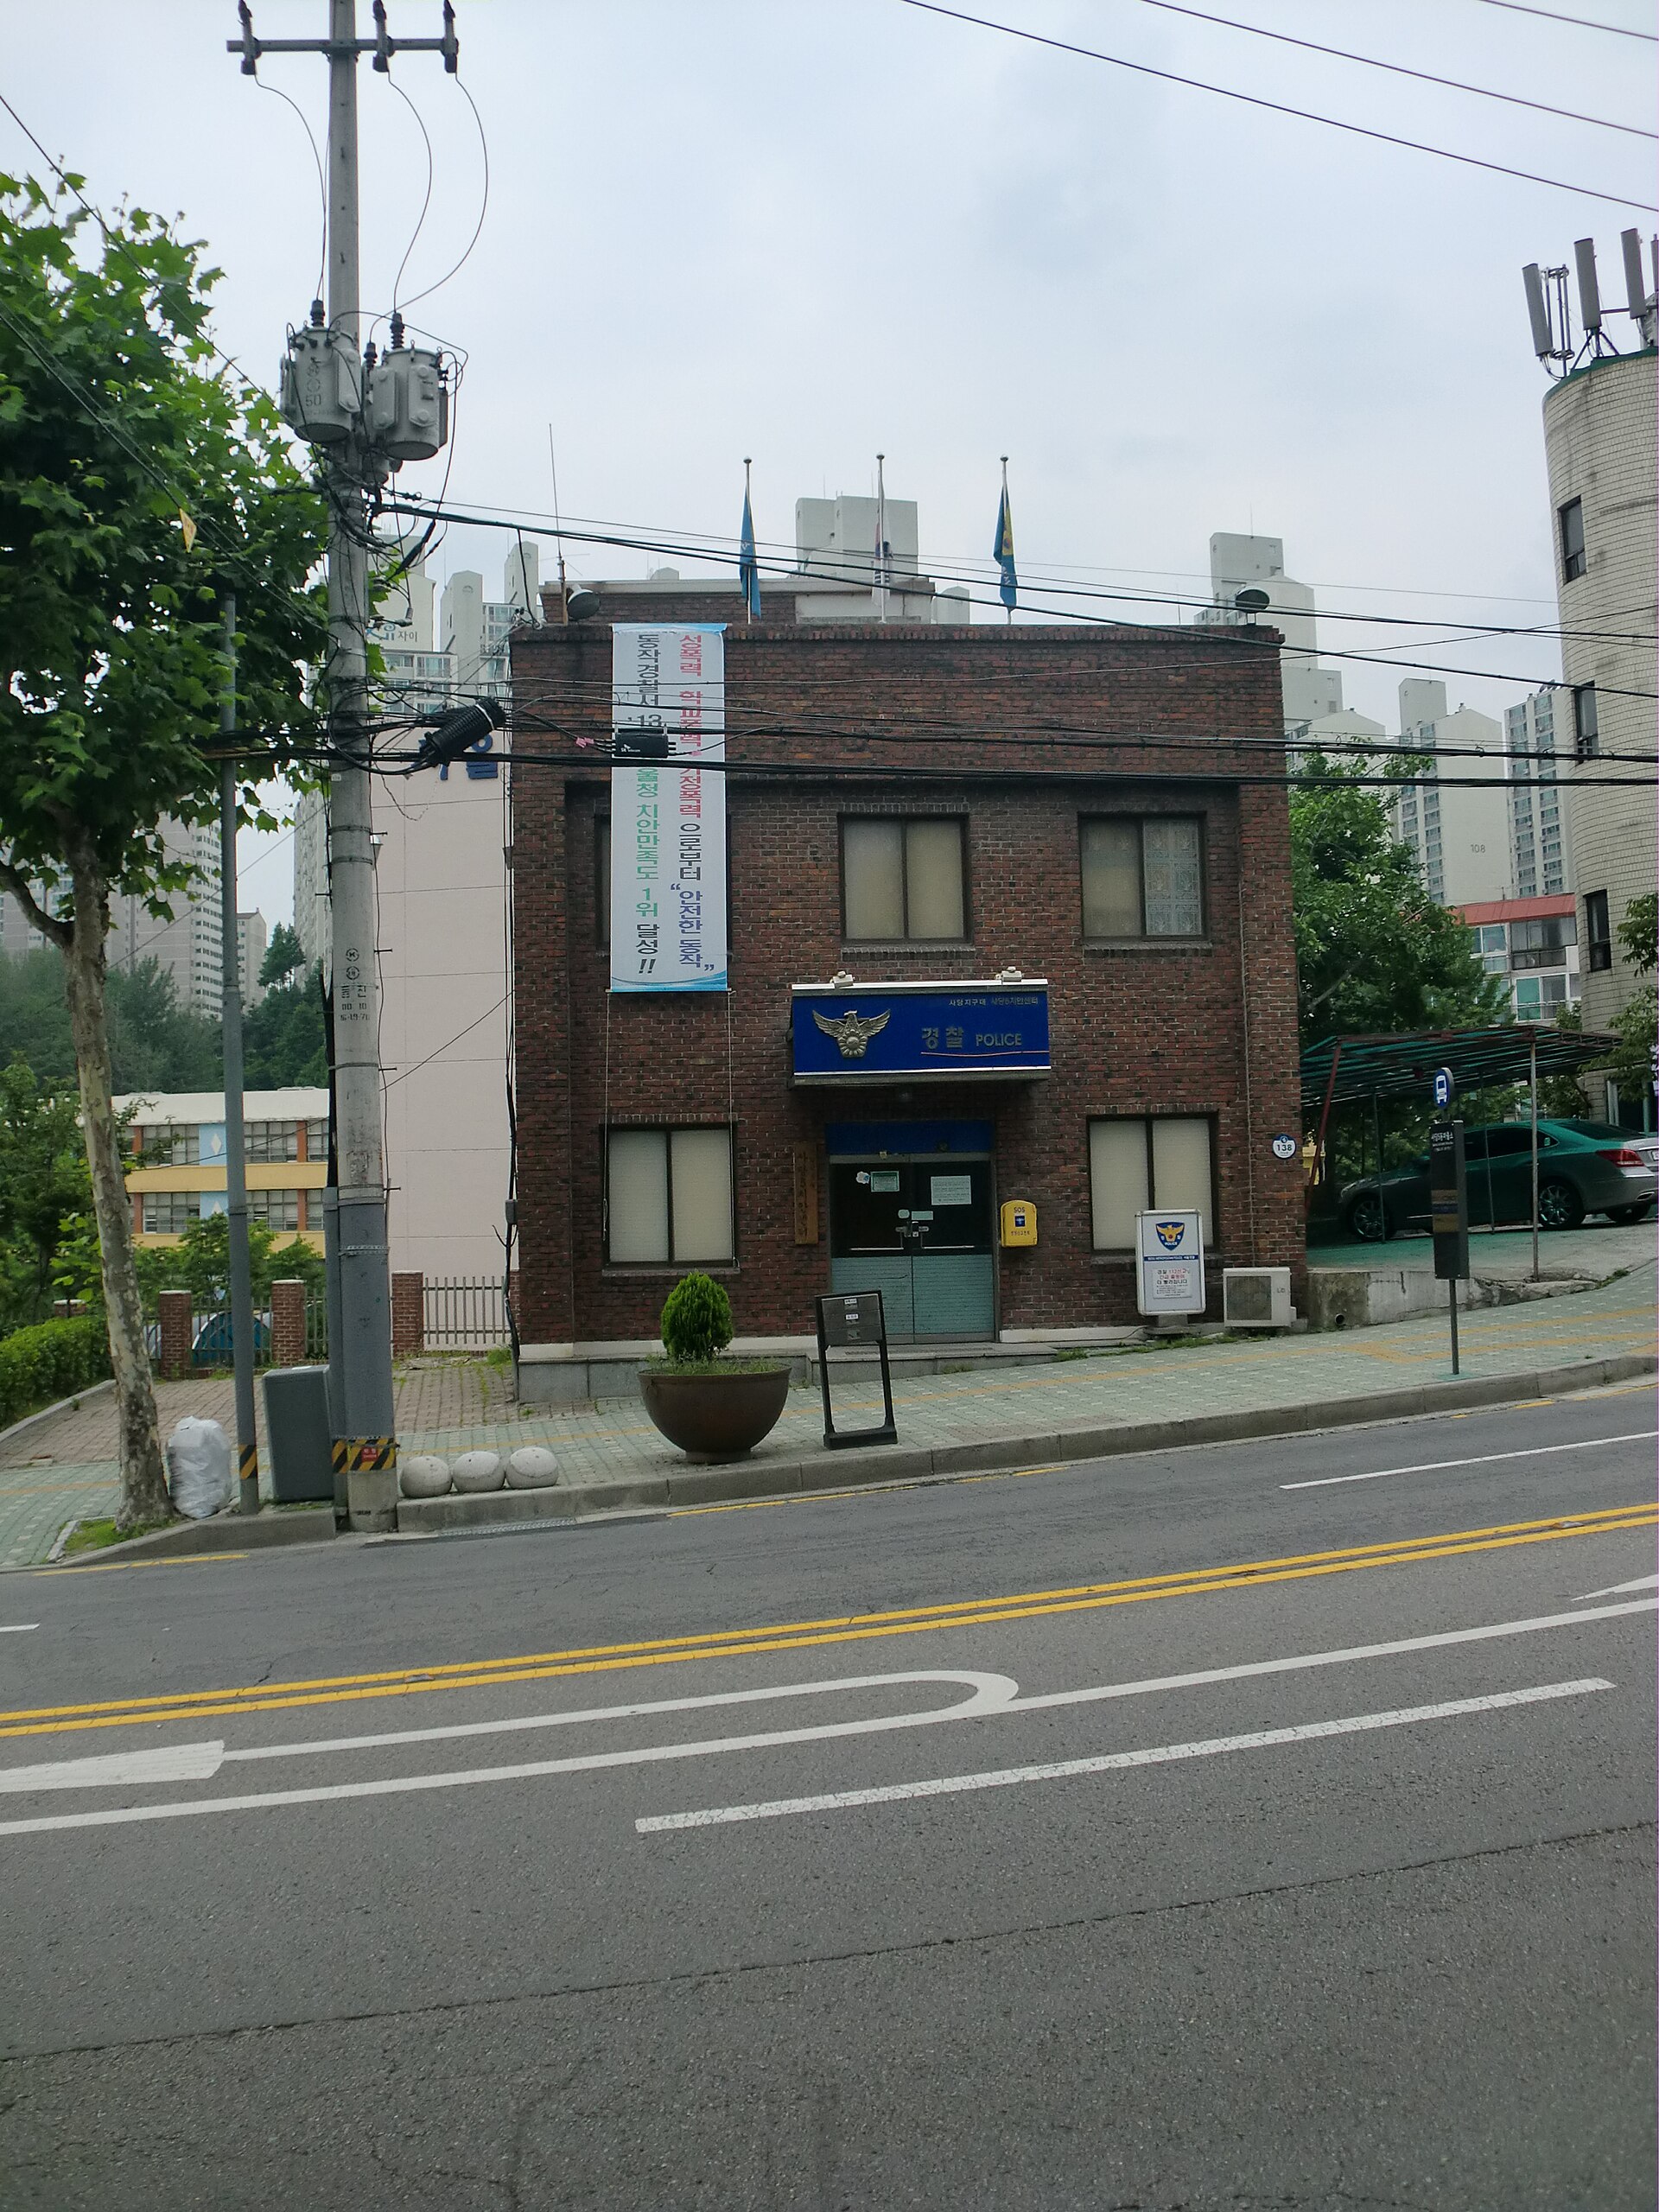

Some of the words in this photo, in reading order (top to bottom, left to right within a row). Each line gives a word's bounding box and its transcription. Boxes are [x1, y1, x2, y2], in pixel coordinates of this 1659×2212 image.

[398, 631, 418, 642] 자이
[637, 634, 661, 706] 동작경찰서
[679, 635, 702, 677] 성폭력
[636, 804, 660, 880] 치안만족도
[678, 823, 702, 880] 으로부터
[1471, 844, 1486, 853] 108
[636, 888, 658, 917] 1위
[976, 1033, 1022, 1046] POLICE
